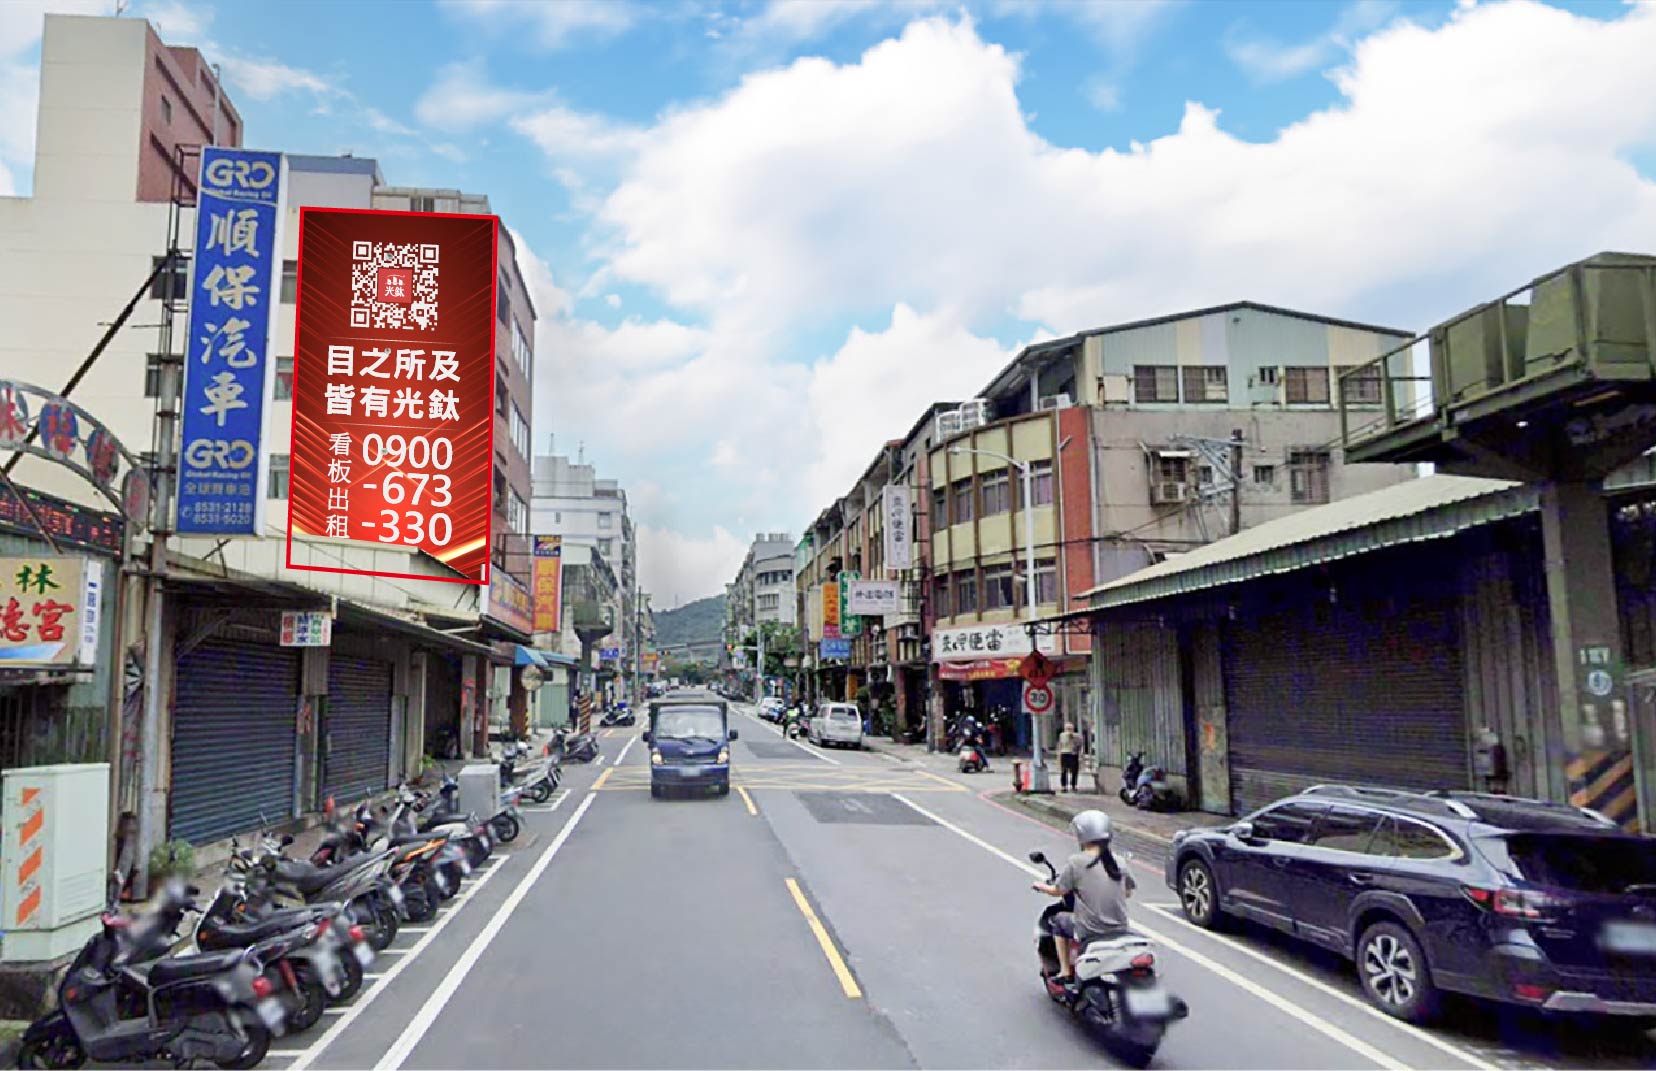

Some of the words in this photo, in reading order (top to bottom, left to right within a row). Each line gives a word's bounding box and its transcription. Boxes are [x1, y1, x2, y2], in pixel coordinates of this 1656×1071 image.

[384, 286, 405, 297] 光鈦
[201, 208, 260, 426] 順保汽車
[326, 344, 461, 383] 目之所及
[324, 382, 461, 422] 皆有光鈦
[361, 433, 454, 471] 0900
[325, 432, 352, 539] 看板出租
[362, 471, 454, 508] -673
[361, 509, 454, 546] -330
[1030, 692, 1047, 704] 30
